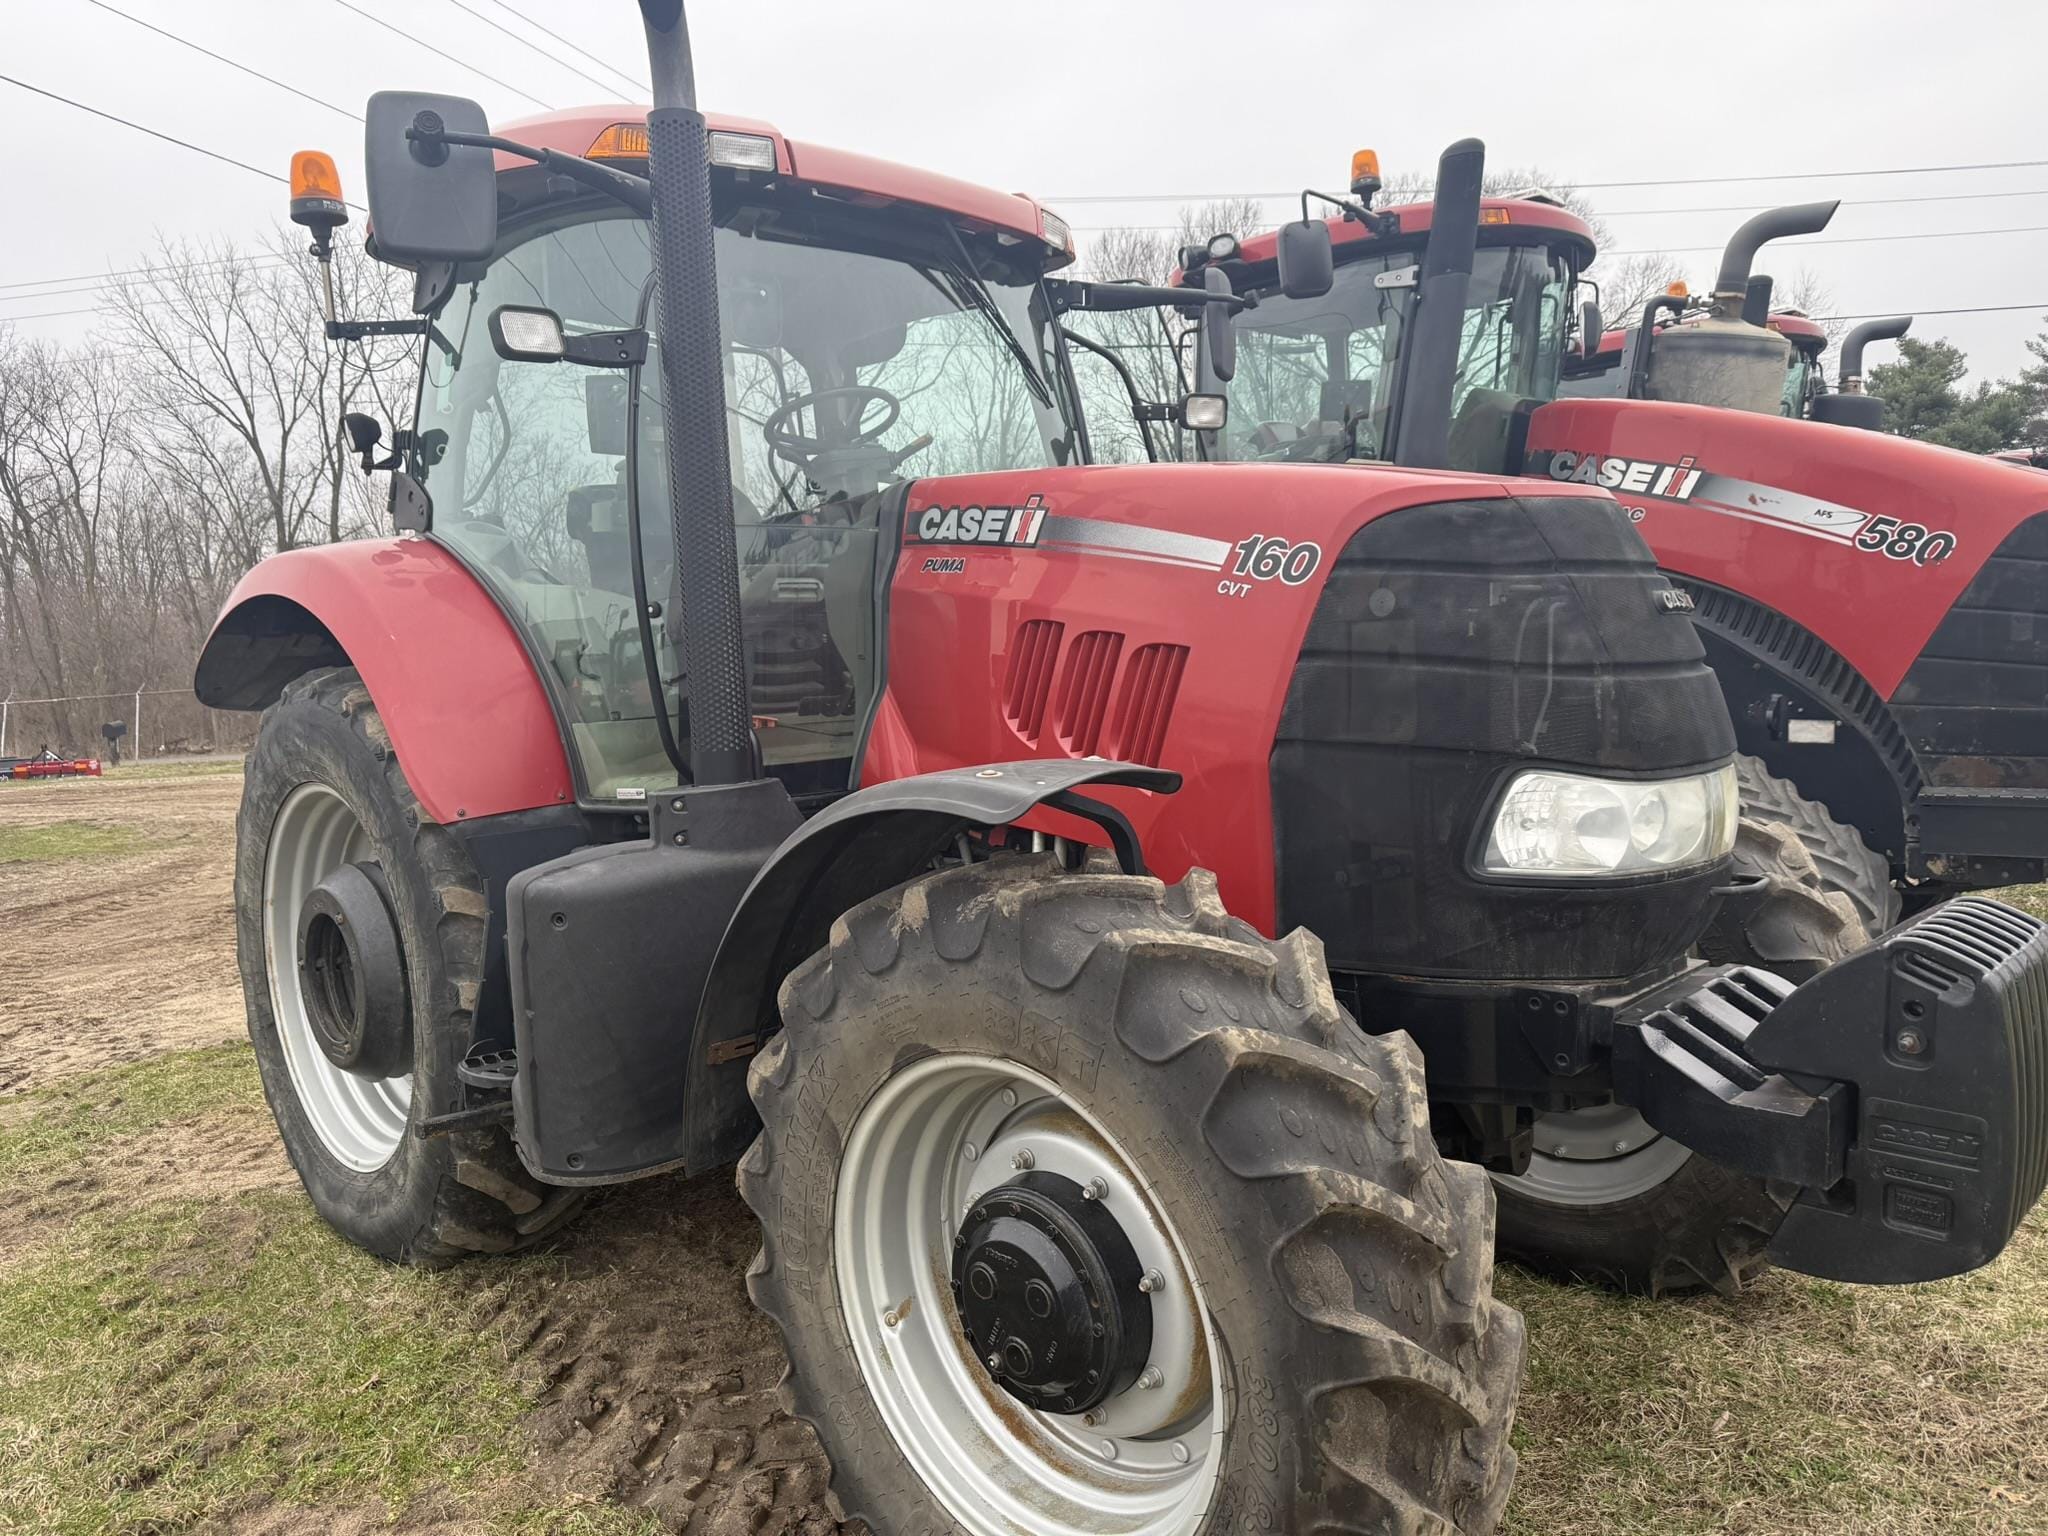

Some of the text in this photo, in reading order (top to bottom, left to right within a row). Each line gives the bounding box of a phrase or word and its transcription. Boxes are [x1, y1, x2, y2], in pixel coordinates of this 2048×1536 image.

[919, 507, 1008, 541] CASE
[1814, 508, 1833, 519] AFS
[1855, 514, 1957, 567] 580
[920, 557, 966, 574] PUMA
[1232, 534, 1322, 586] 160
[1217, 580, 1252, 598] CVT
